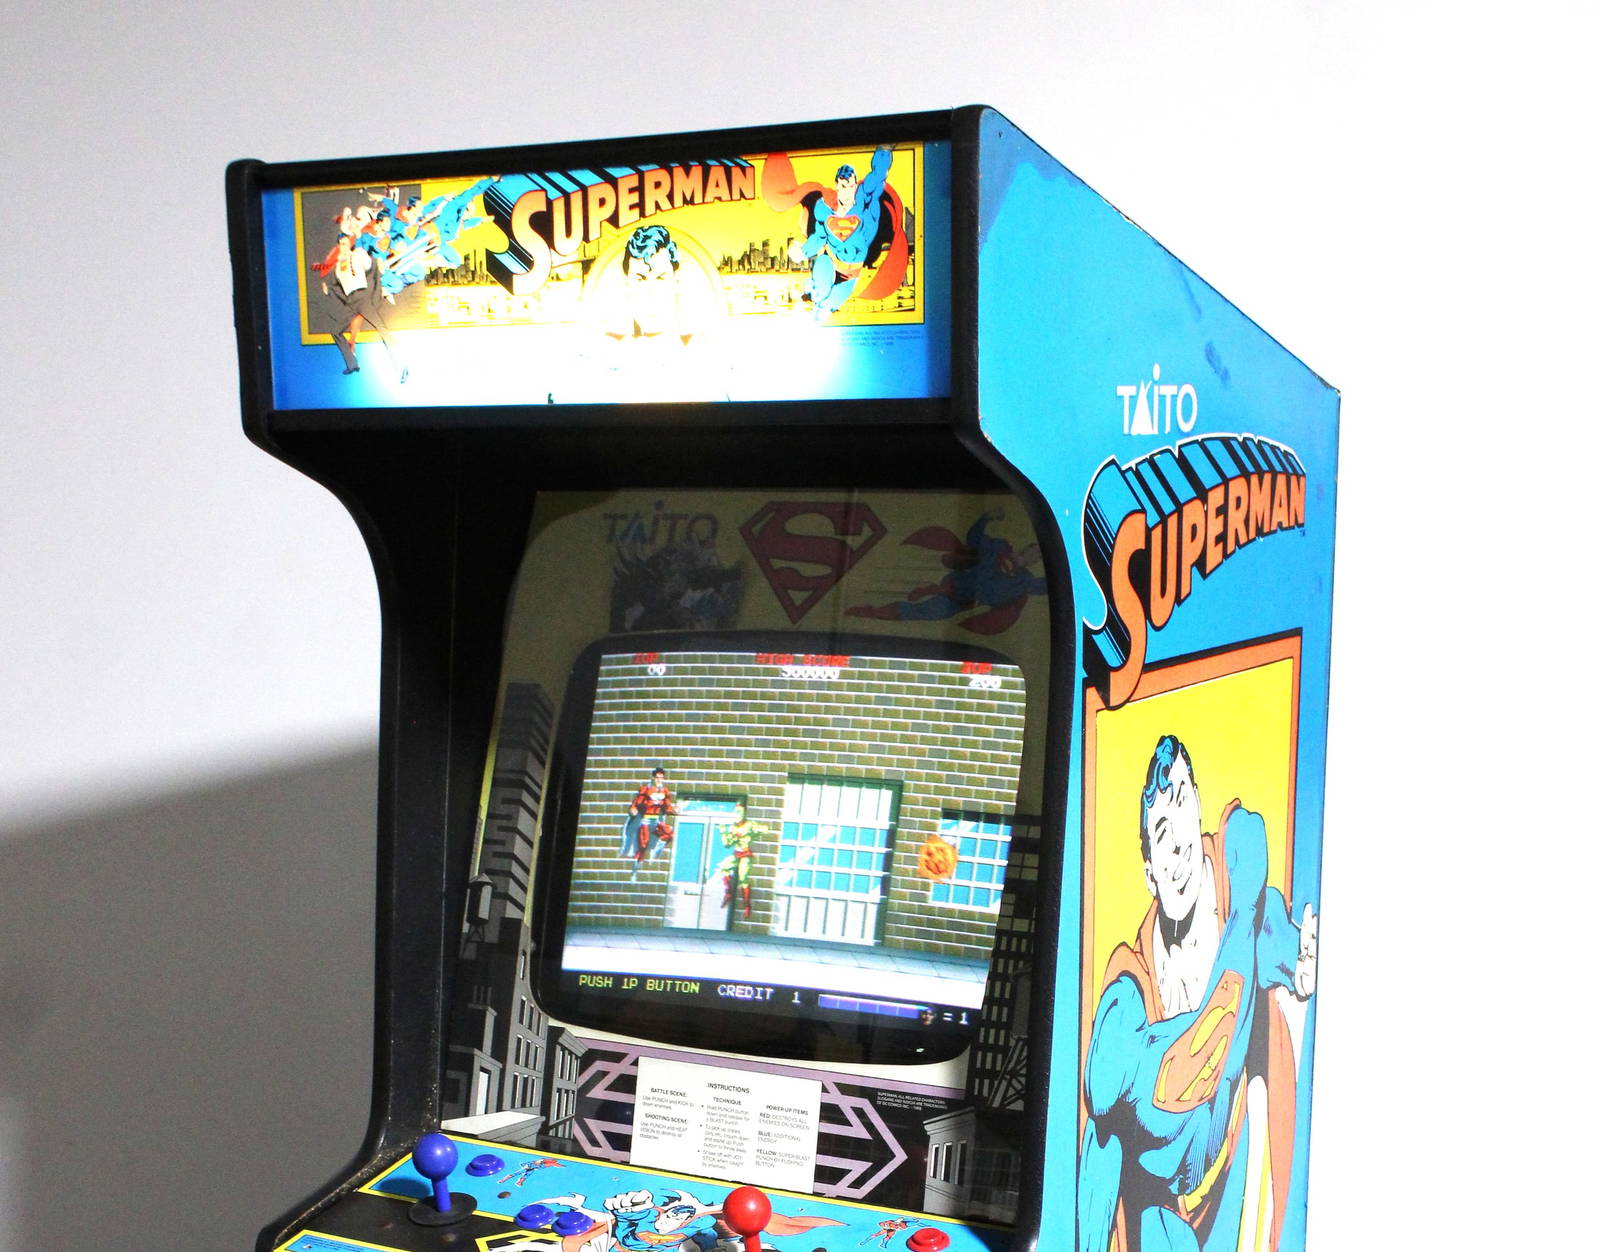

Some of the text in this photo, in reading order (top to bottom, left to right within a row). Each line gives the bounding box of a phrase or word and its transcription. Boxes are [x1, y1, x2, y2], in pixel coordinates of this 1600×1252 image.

[505, 162, 756, 296] SUPERMAN
[1098, 453, 1306, 710] SUPERMAN
[803, 655, 849, 668] SCORE
[578, 974, 700, 994] PUSH 1P BUTTON
[718, 984, 801, 1004] CREDIT 1
[960, 1012, 968, 1025] 1
[707, 1082, 750, 1094] INSTRUCTIONS
[713, 1096, 742, 1106] TECHNIQUE
[645, 1113, 670, 1122] SHOOTING
